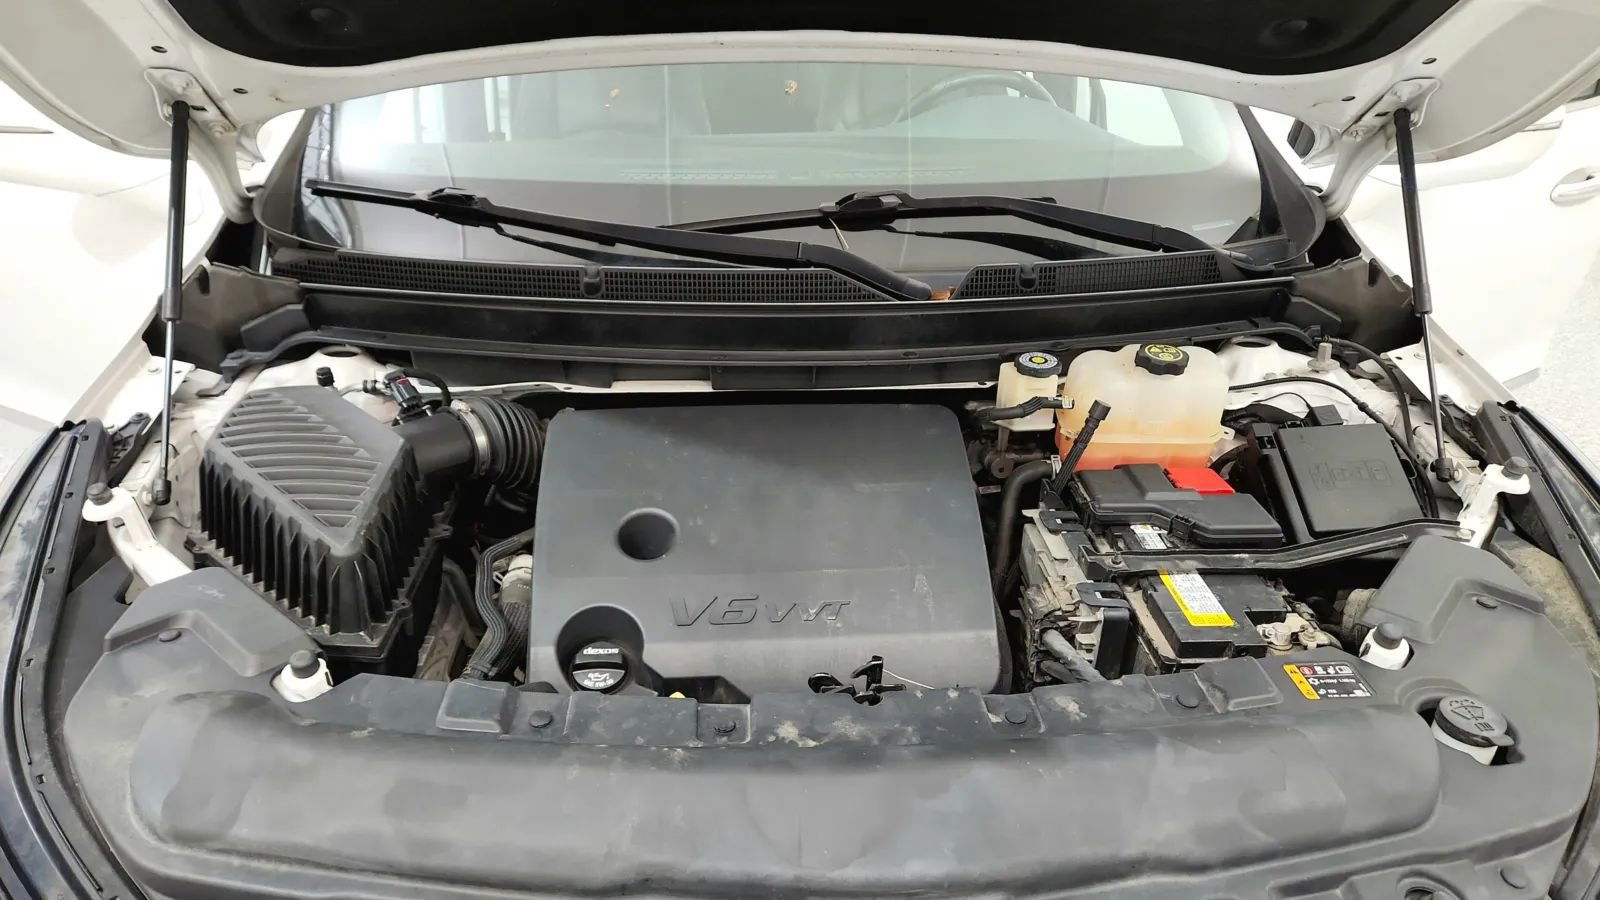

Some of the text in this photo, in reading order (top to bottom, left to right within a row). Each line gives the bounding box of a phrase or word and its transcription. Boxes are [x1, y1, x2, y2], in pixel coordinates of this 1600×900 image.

[671, 594, 851, 627] V6 VVT
[583, 646, 620, 655] dexos
